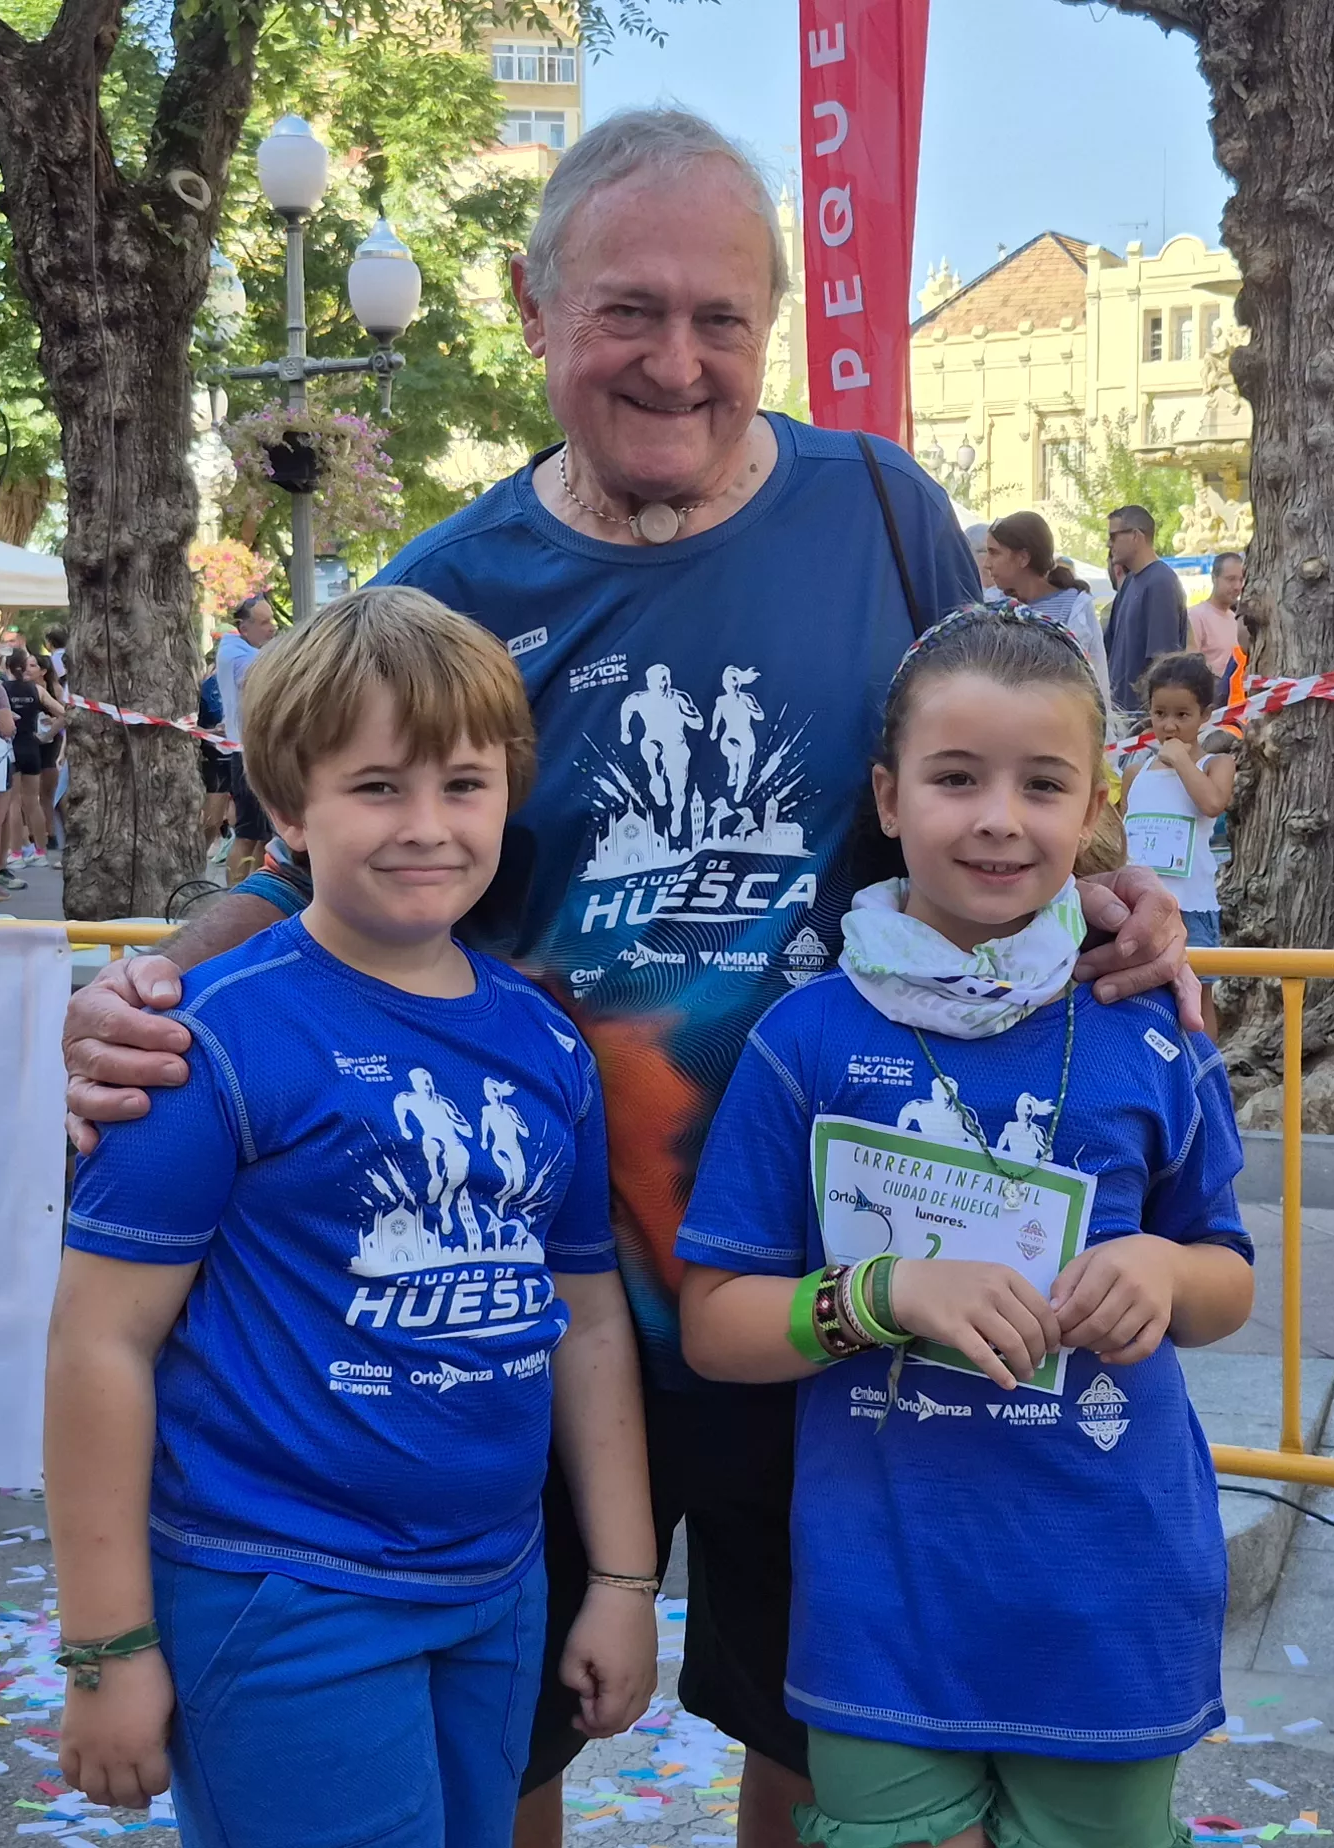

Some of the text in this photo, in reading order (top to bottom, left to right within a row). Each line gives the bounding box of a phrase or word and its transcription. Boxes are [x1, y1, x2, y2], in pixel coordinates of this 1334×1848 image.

[808, 22, 871, 393] PEQUE
[705, 859, 731, 870] DE
[581, 871, 817, 934] HUESCA
[712, 951, 769, 965] AMBAR
[788, 955, 825, 966] SPAZIO
[863, 1055, 915, 1067] EDICIÓN
[853, 1146, 933, 1181] CARRERA
[828, 1189, 892, 1217] OrtoAvanza
[882, 1179, 1000, 1219] CIUDAD DE HUESCA
[915, 1206, 968, 1229] lunares.
[396, 1267, 516, 1287] CIUDAD DE
[329, 1360, 393, 1379] embou
[410, 1368, 493, 1386] OrtoAvanza
[329, 1380, 393, 1396] BIOMOVIL
[850, 1385, 887, 1402] embou
[897, 1397, 972, 1417] OrtoAvanza
[1003, 1403, 1063, 1419] AMBAR
[1082, 1403, 1123, 1416] SPAZIO
[1009, 1418, 1036, 1426] TRIPLE
